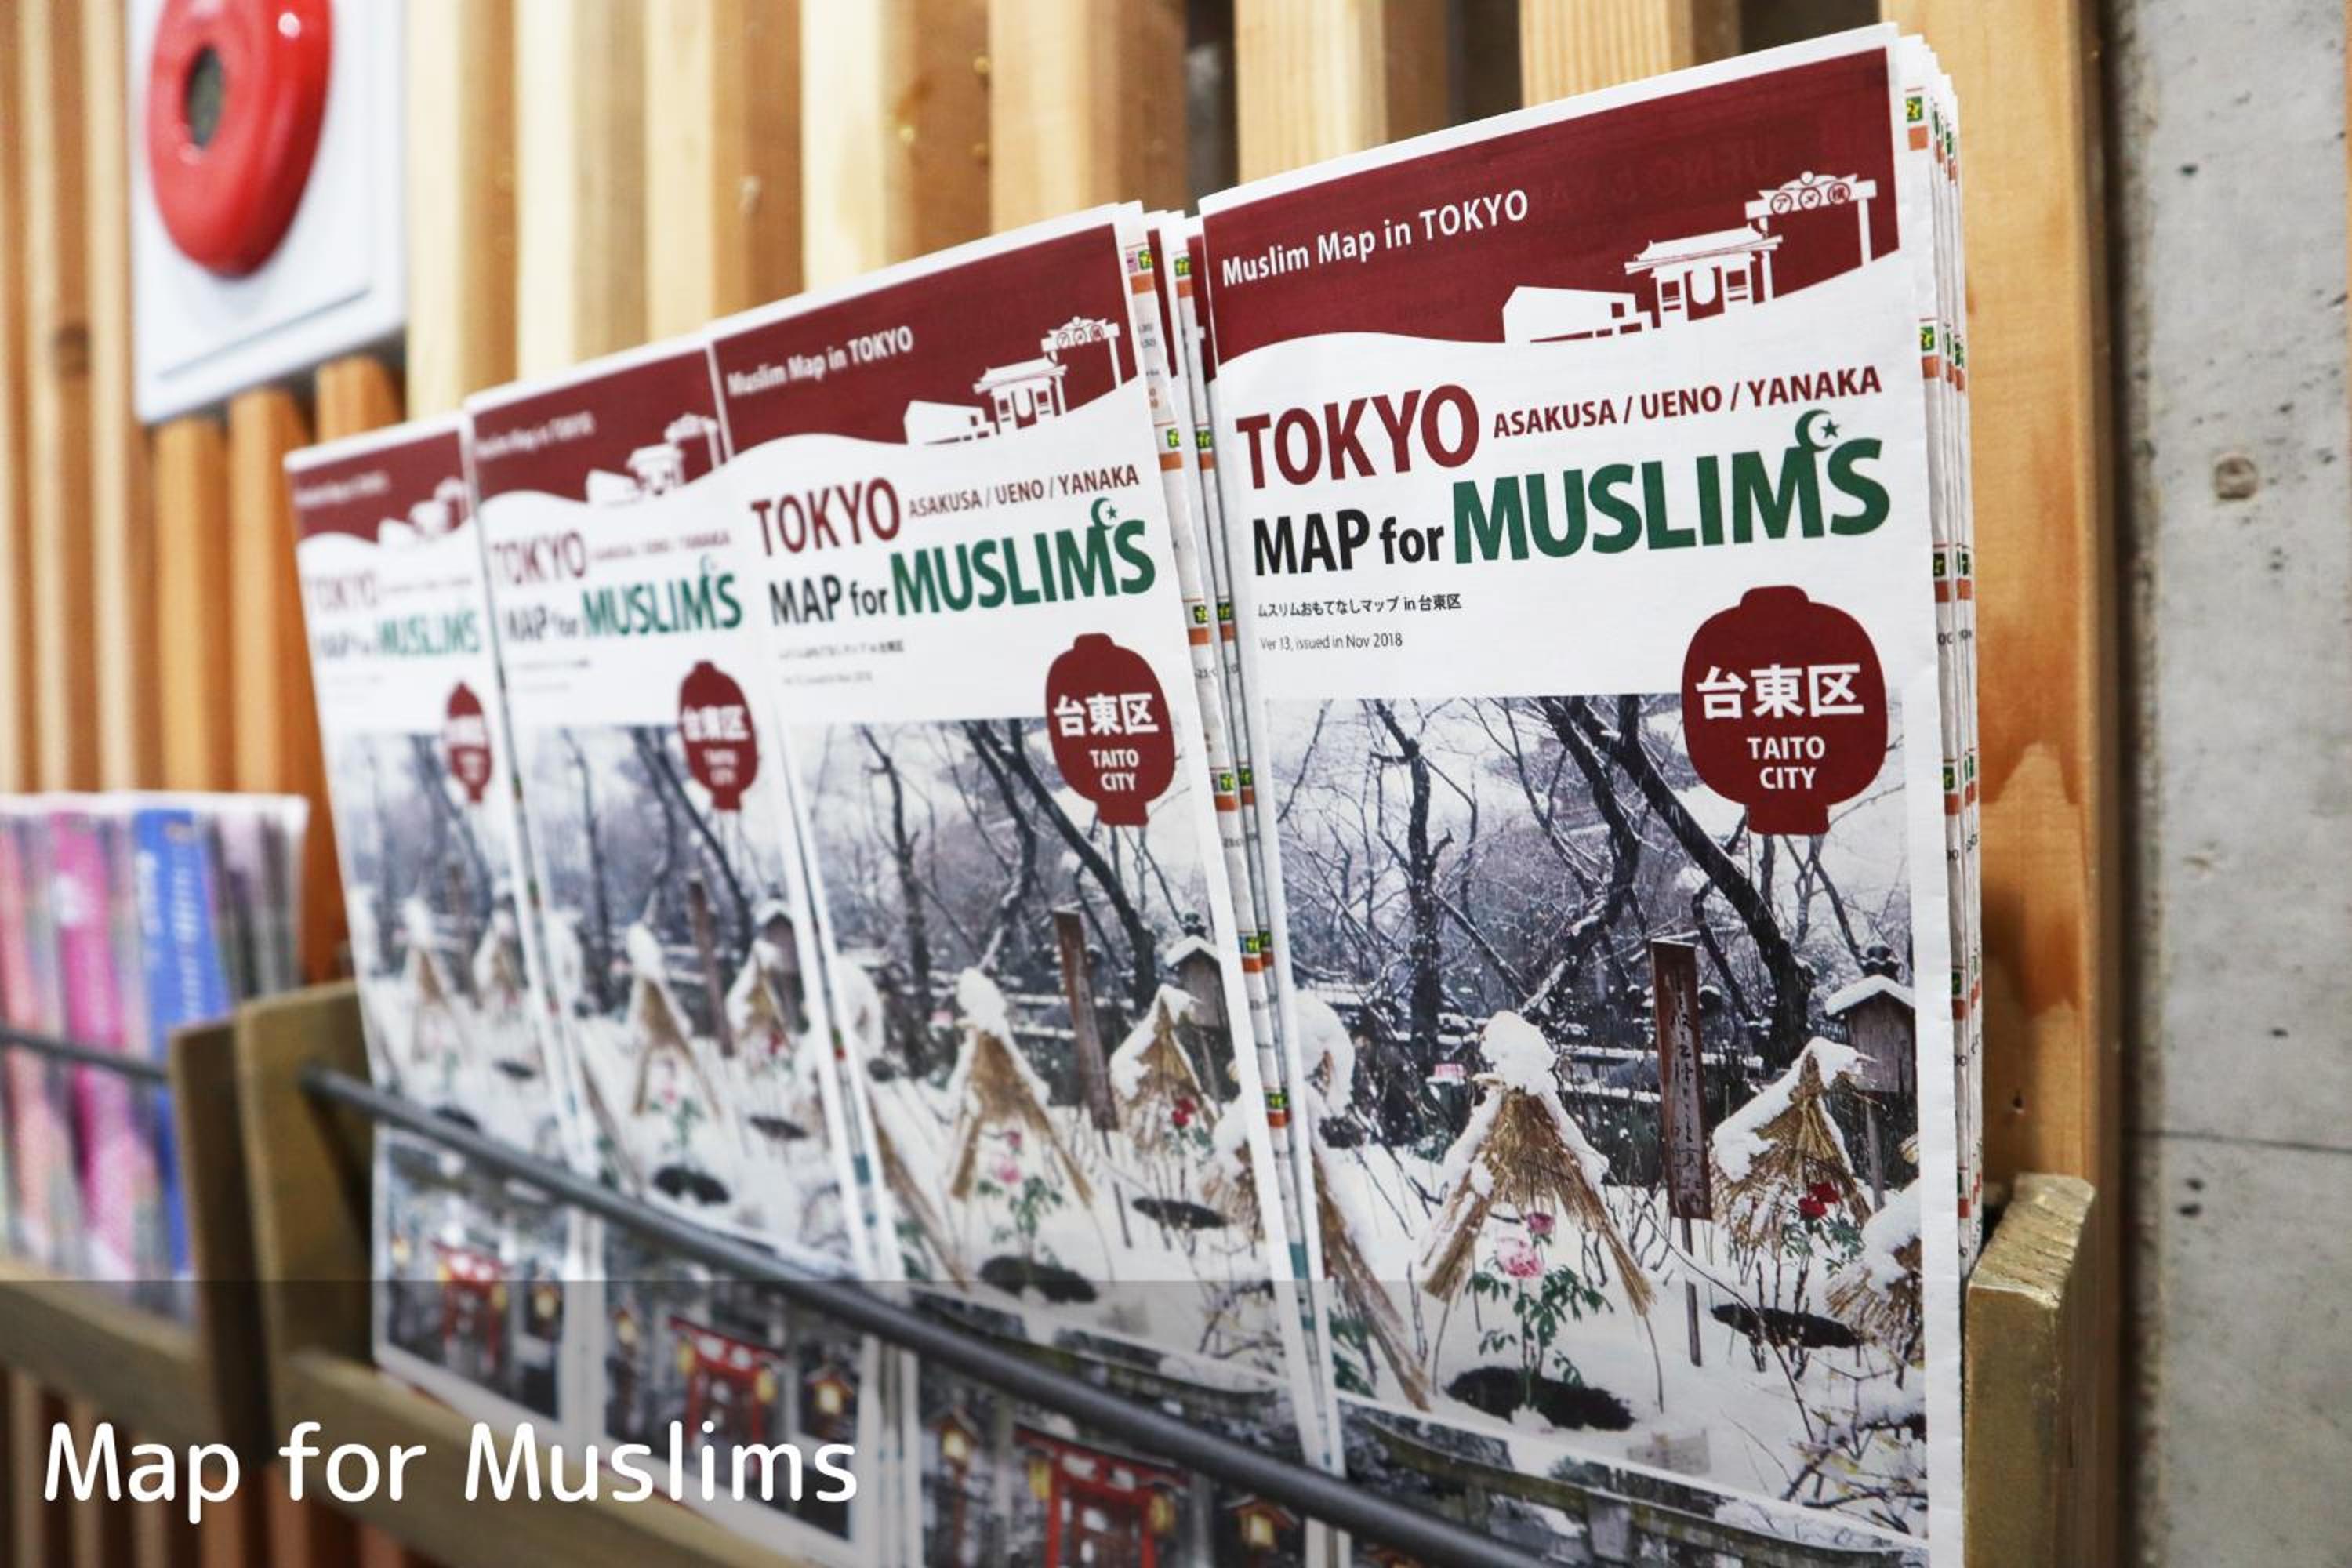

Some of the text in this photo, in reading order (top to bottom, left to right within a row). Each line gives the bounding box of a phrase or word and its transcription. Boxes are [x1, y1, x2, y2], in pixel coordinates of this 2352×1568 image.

[1223, 189, 1528, 287] Muslim Map in TOKYO
[728, 325, 913, 396] Muslim Map in TOKYO
[1494, 365, 1882, 439] ASAKUSA / UENO / YANAKA
[1235, 384, 1479, 489] TOKYO
[750, 477, 902, 557] TOKYO
[908, 488, 982, 520] ASAKUSA
[994, 478, 1044, 505] UENO
[1058, 464, 1140, 495] YANAKA
[1253, 436, 1891, 576] MAP for MUSLIMS
[769, 519, 1156, 626] MAP for MUSLIMS
[583, 574, 742, 638] MUSLIMS
[1258, 593, 1462, 618] ムスリムおもてなしマップ in 台東区
[1260, 632, 1403, 652] Ver 13, issued in Nov 2018
[1053, 692, 1159, 737] 台東区
[1696, 663, 1864, 720] 台東区
[1089, 748, 1139, 768] TAITO
[1746, 735, 1826, 760] TAITO
[1100, 772, 1136, 791] CITY
[1759, 766, 1817, 789] CITY
